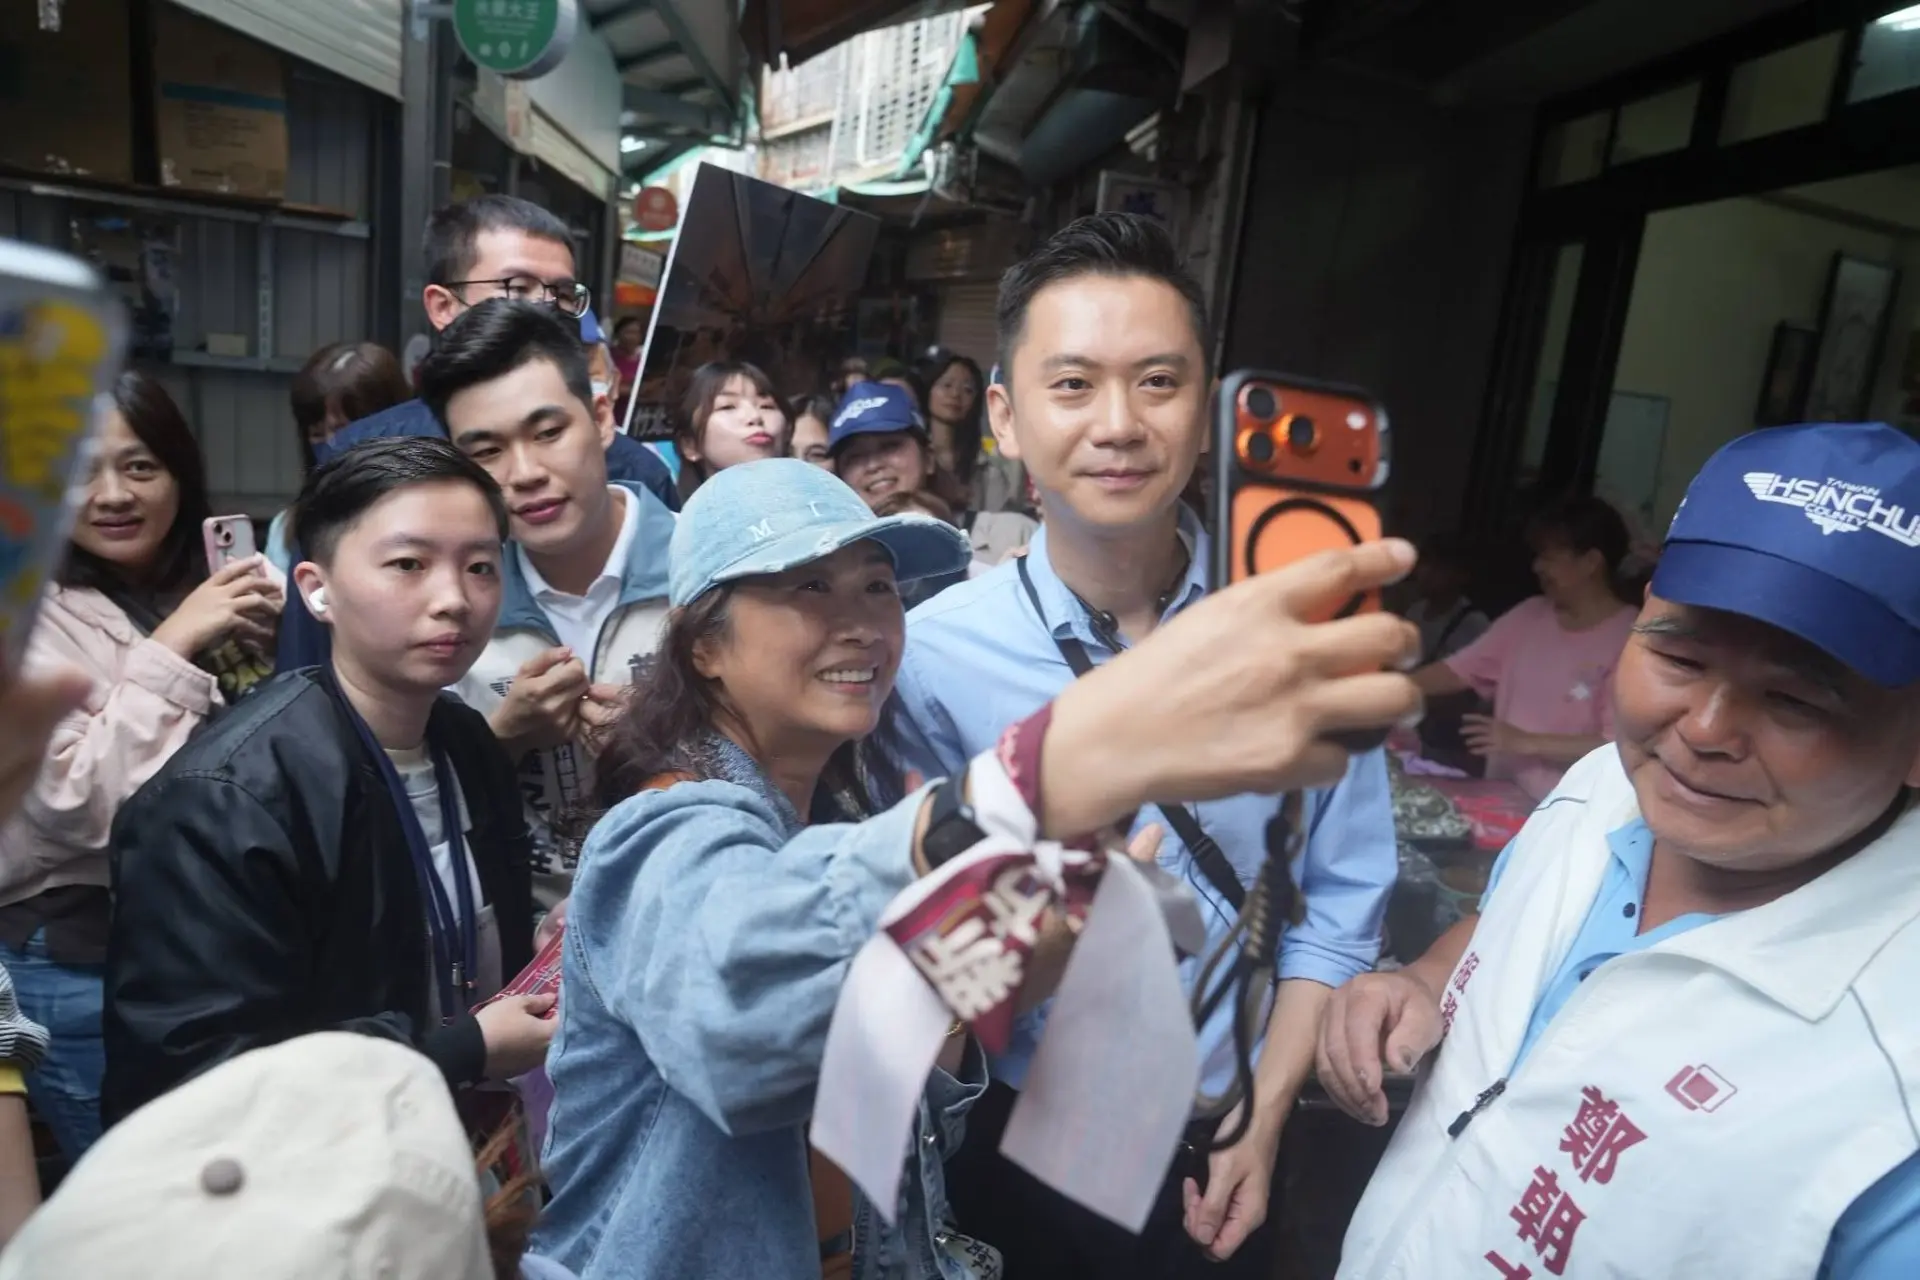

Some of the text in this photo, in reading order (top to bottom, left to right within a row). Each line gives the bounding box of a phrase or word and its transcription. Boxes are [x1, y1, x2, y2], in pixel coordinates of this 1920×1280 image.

[1826, 477, 1880, 496] TAIWAN
[1769, 474, 1918, 537] HSINCHU
[1805, 503, 1867, 527] COUNTY
